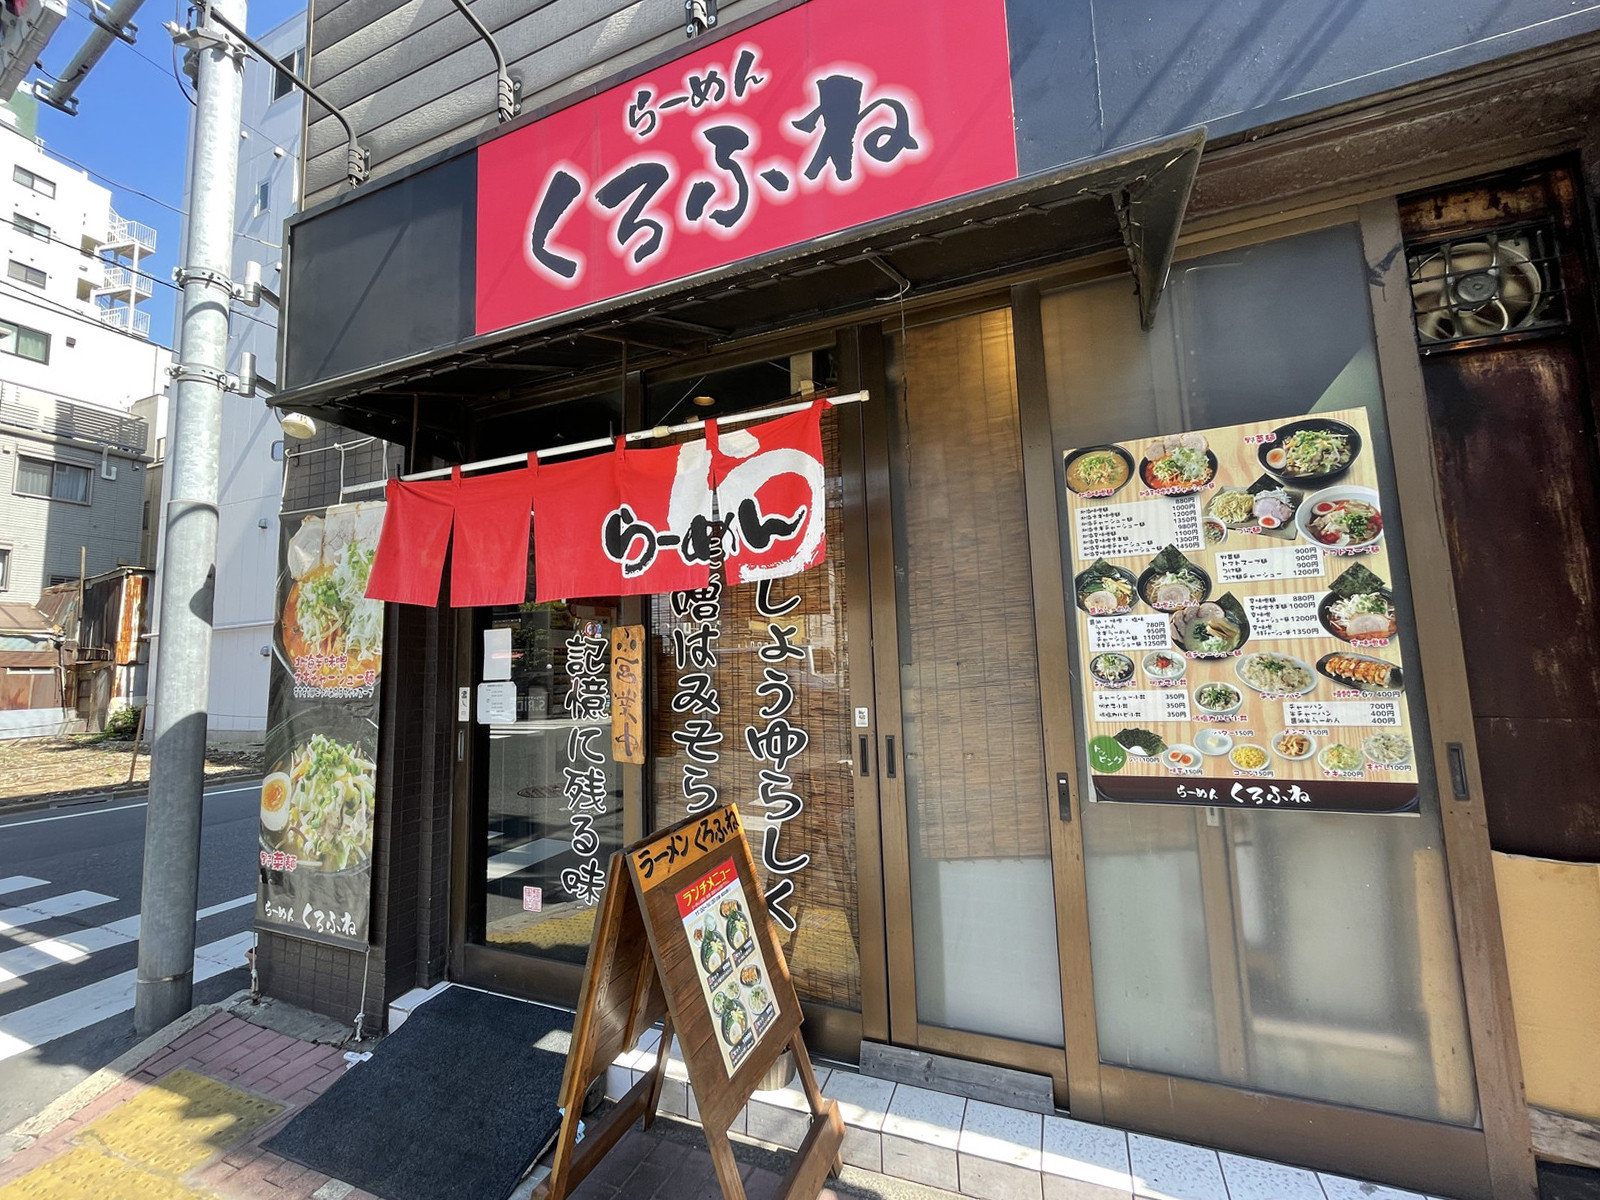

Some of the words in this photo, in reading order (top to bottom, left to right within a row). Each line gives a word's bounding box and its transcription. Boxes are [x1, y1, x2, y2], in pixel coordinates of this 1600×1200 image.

[628, 50, 764, 137] らーめん
[530, 75, 919, 279] くろふね
[1173, 516, 1197, 524] 1350円
[602, 497, 809, 579] らーめん
[1175, 529, 1198, 537] 1100円
[1176, 535, 1199, 543] 1300円
[1293, 568, 1319, 576] 1200円
[1293, 594, 1315, 602] 880円
[1291, 614, 1317, 622] 1200円
[560, 634, 611, 906] 記憶に残る味
[1176, 784, 1219, 800] らーめん
[1230, 782, 1311, 805] くろふね
[638, 835, 689, 878] ラーメン
[694, 808, 740, 852] くろふね
[260, 851, 297, 872] 野菜麺
[682, 868, 731, 907] ランチメニュー
[265, 901, 294, 922] らーめん
[302, 903, 357, 935] くろふね
